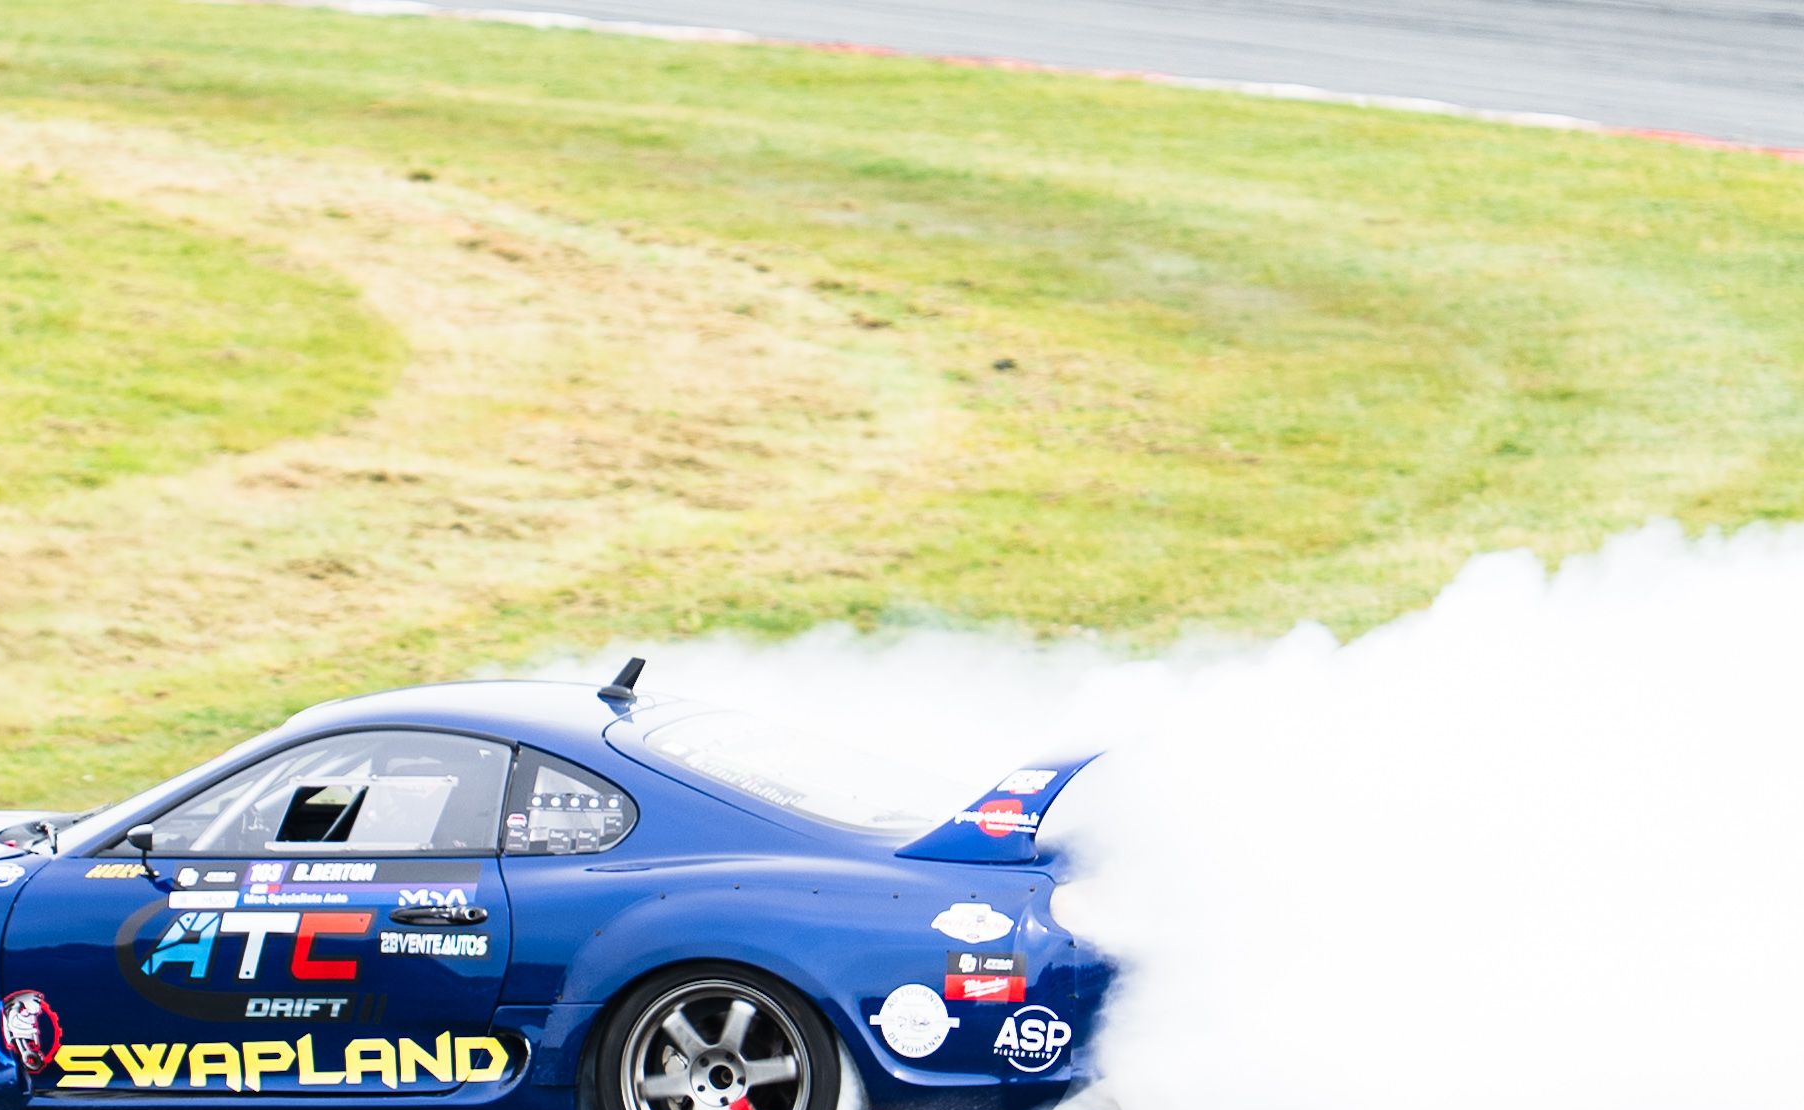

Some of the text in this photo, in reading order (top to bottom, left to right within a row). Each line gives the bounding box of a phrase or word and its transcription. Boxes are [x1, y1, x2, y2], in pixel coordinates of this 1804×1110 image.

[250, 863, 283, 882] 103
[141, 911, 372, 979] ATC
[245, 998, 348, 1018] DRIFT
[901, 1033, 942, 1054] YOHANN
[994, 1016, 1071, 1052] ASP
[54, 1030, 509, 1092] SWAPLAND
